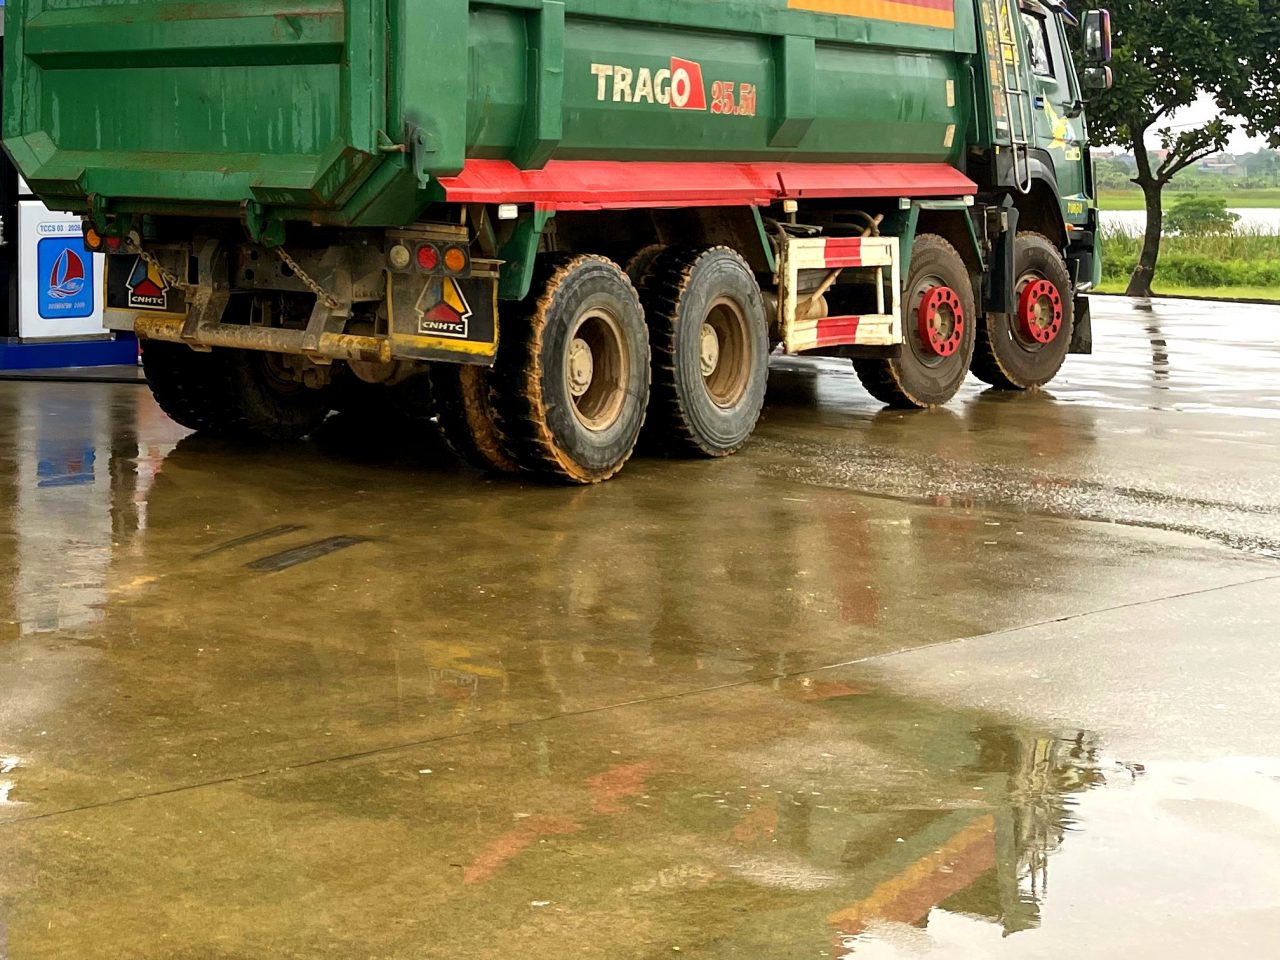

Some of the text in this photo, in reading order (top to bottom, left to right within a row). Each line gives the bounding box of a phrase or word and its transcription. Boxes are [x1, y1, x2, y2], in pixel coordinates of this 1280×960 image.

[591, 63, 691, 107] TRAGO
[132, 296, 164, 304] CNHTC
[422, 320, 464, 333] CNHTC
